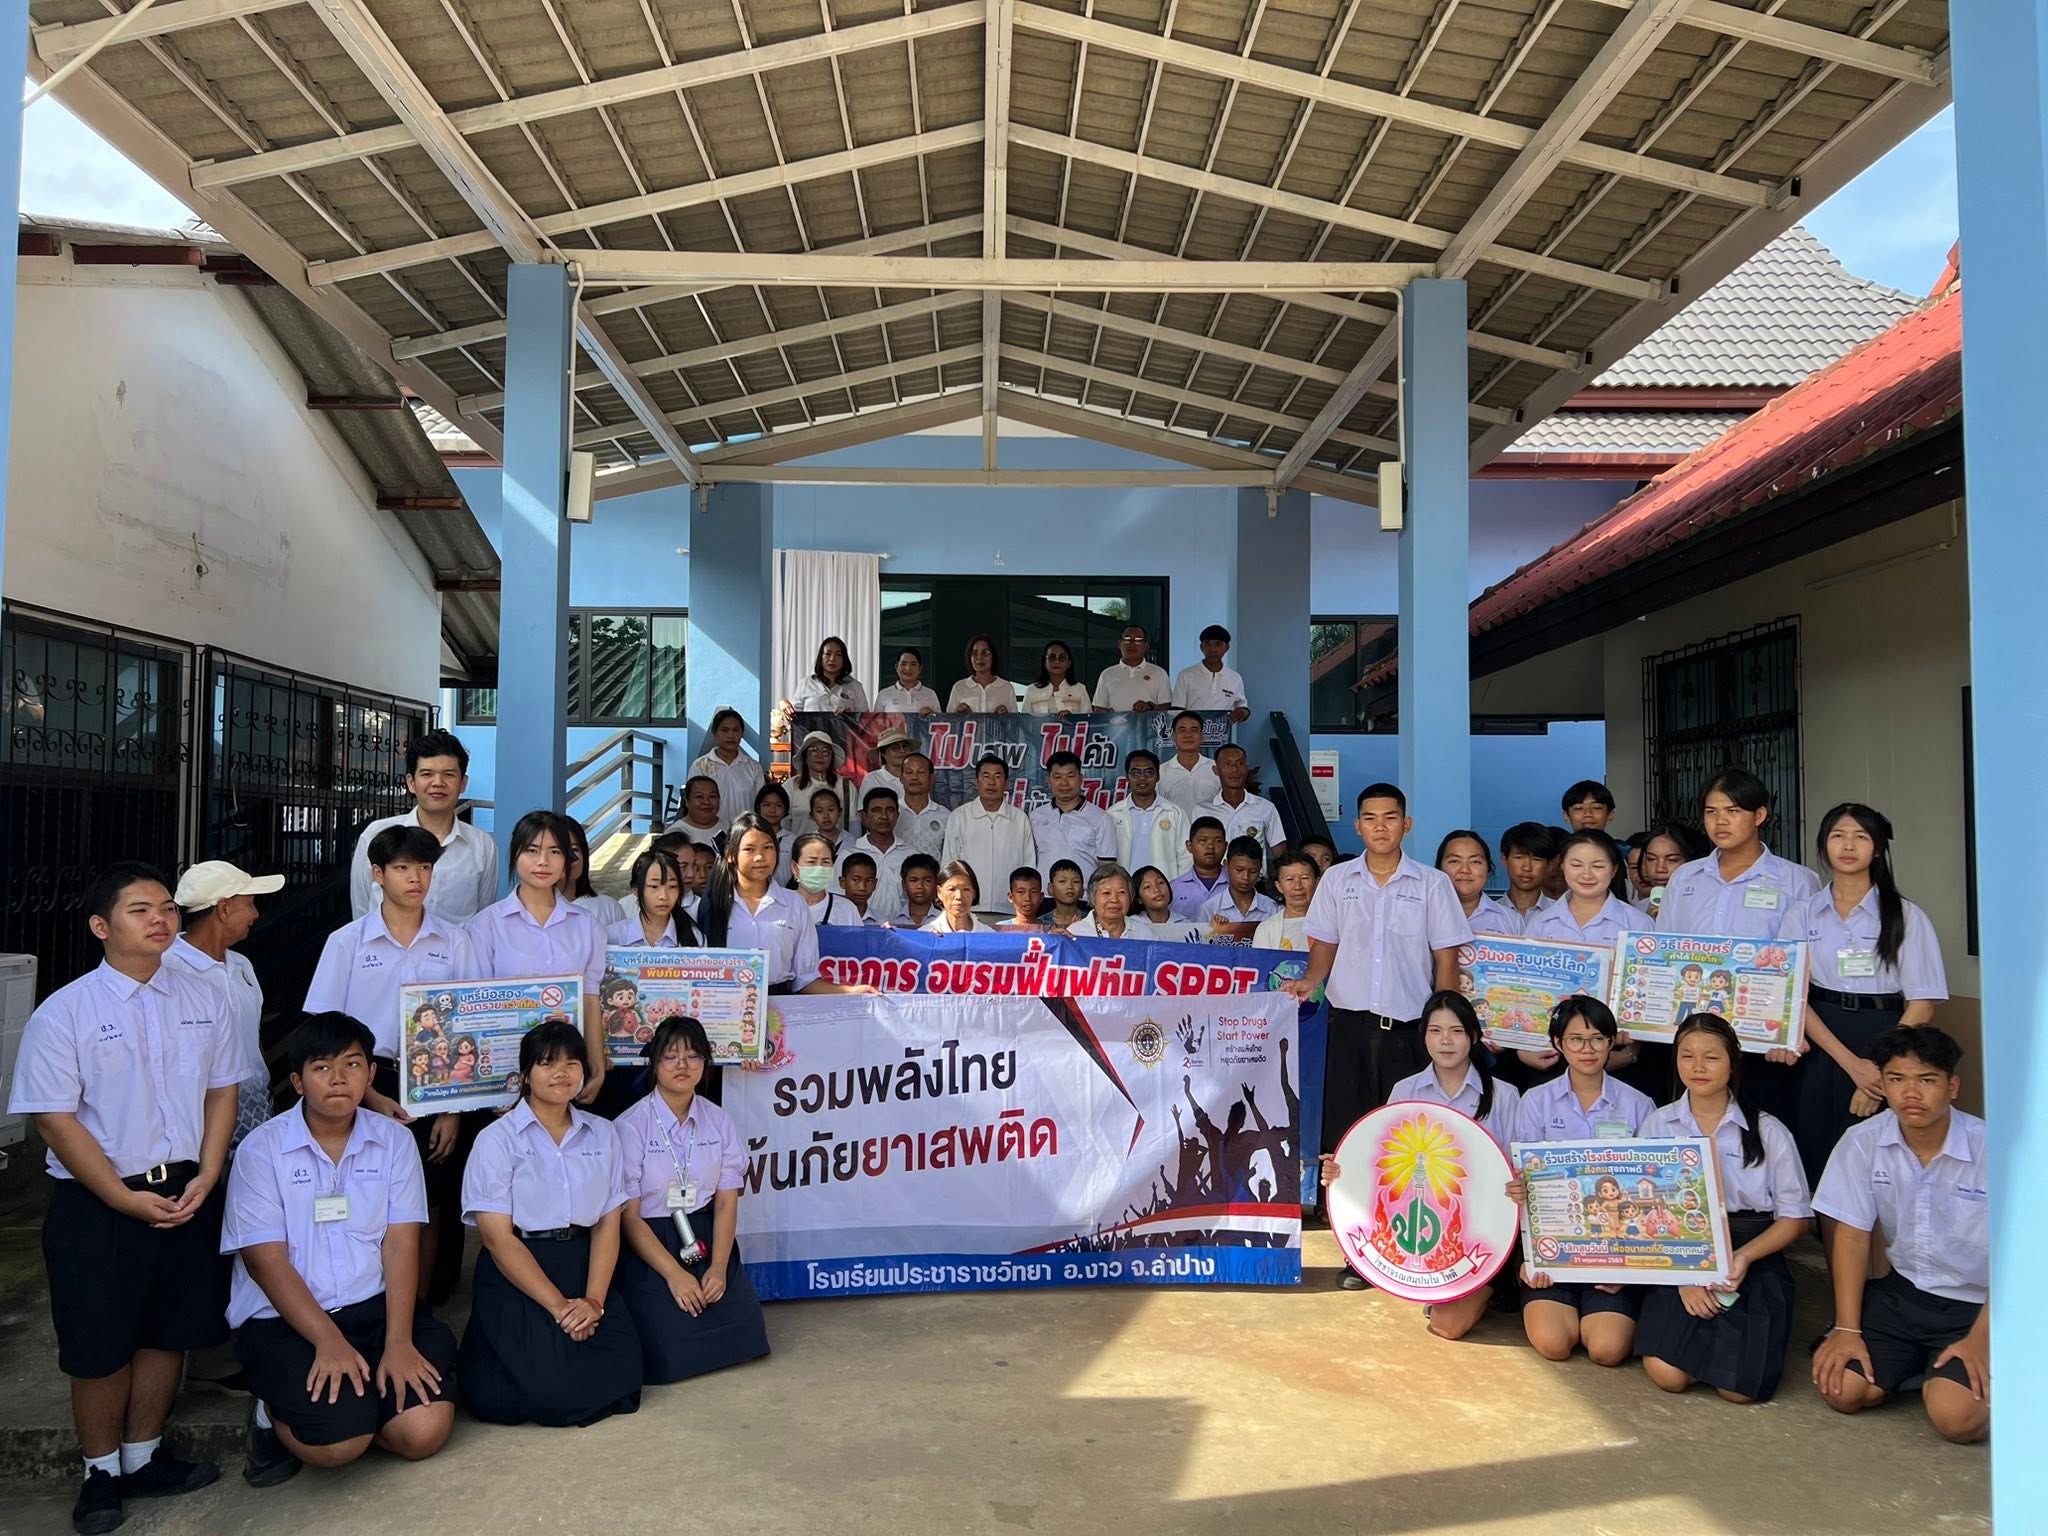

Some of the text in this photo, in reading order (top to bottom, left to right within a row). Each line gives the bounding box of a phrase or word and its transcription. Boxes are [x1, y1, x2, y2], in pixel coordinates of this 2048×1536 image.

[1660, 938, 1731, 955] วิธีเลิกบุหรี่
[1477, 944, 1586, 974] วันงดสูบบุหรี่โลก
[646, 967, 725, 980] พิษภัยจากบุหรี่
[460, 988, 521, 1003] บุหรี่มือสอง
[1218, 1016, 1268, 1029] Stop Drugs
[1217, 1030, 1270, 1041] Start Power
[772, 1040, 1017, 1117] รวมพลังไทย
[738, 1108, 1058, 1197] พ้นภัยยาเสพติด
[1545, 1147, 1679, 1166] ร่วมสร้างโรงเรียนปลอดบุหรี่
[807, 1252, 1215, 1292] โรงเรียนประชาราชวิทยา อ.งาว จ.ลำปาง
